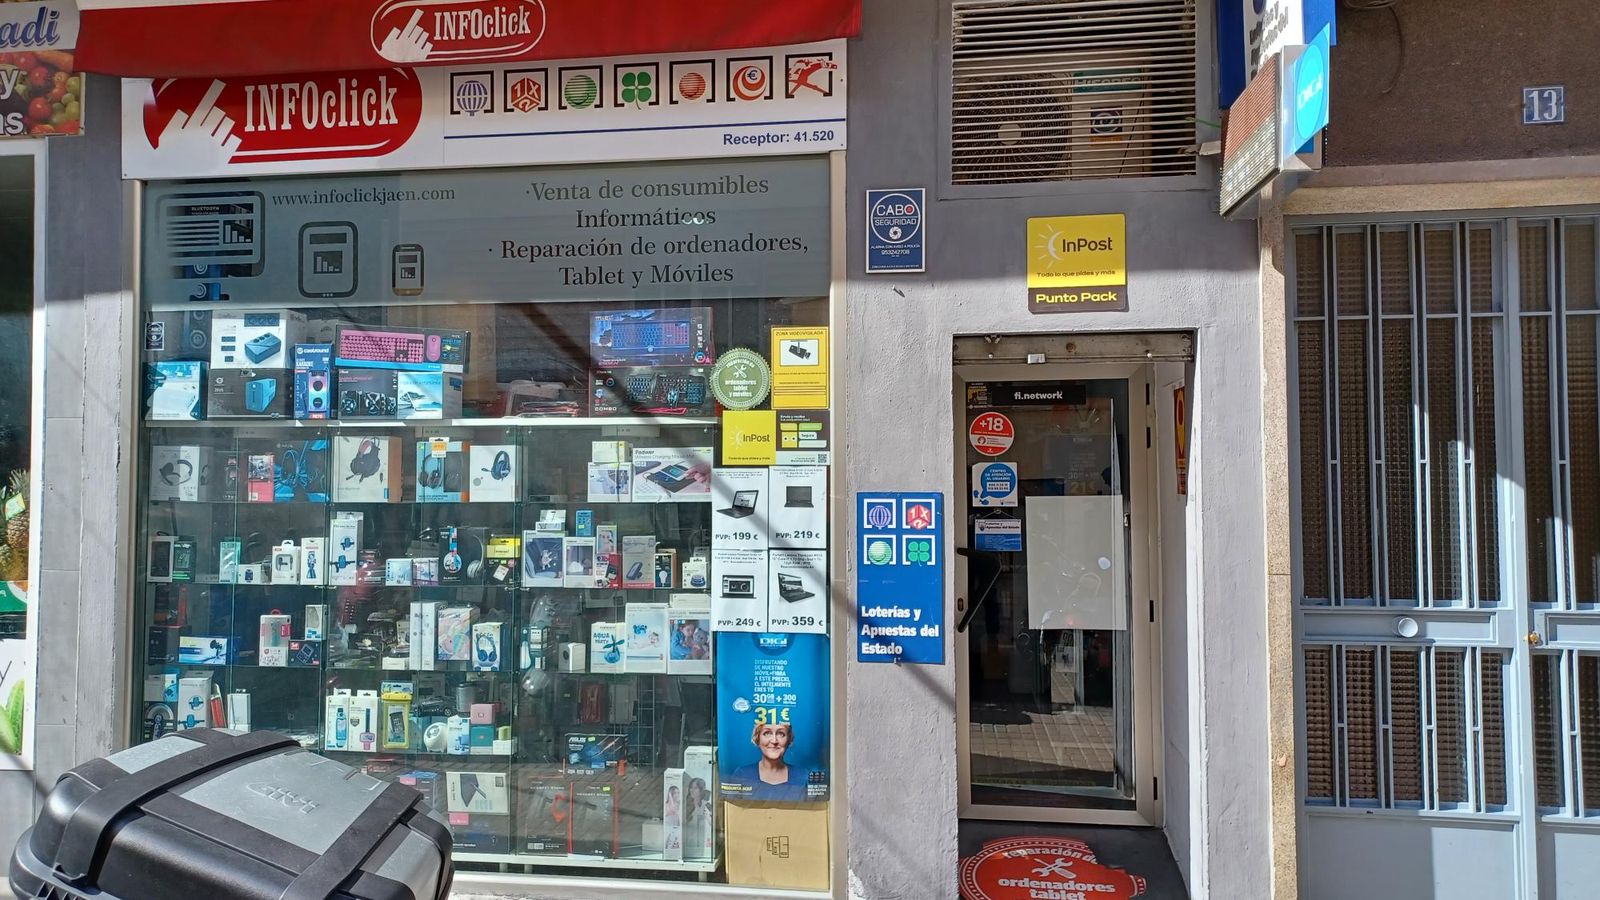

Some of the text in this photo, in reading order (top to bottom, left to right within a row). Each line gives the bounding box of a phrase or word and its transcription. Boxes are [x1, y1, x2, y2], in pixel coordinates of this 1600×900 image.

[433, 7, 532, 40] INFOclick
[244, 75, 399, 133] INFOclick
[1528, 89, 1557, 121] 13
[0, 112, 24, 135] s
[723, 129, 834, 146] Receptor: 41.520
[598, 179, 625, 199] de
[631, 174, 769, 198] consumibles
[271, 186, 456, 207] www.infoclickjaen.com
[575, 205, 717, 229] Informáticos
[876, 204, 915, 216] CABO
[874, 218, 917, 226] SEGURIDAD
[500, 232, 809, 262] Reparación de ordenadores,
[1062, 236, 1113, 253] InPost
[559, 262, 735, 289] Tablet y Móviles
[1075, 271, 1094, 279] pides
[1036, 291, 1118, 304] Punto Pack
[979, 416, 1004, 431] +18
[743, 434, 770, 443] InPost
[732, 532, 751, 540] 199
[793, 531, 813, 539] 219
[771, 618, 790, 626] PVP:
[792, 616, 814, 626] 359
[861, 606, 921, 621] Loterías y
[735, 618, 754, 626] 249
[861, 624, 940, 638] Apuestas del
[861, 643, 903, 655] Estado
[753, 693, 767, 704] 30
[754, 707, 790, 727] 31 €
[1002, 847, 1082, 860] reparación
[998, 877, 1116, 893] ordenadores
[1030, 889, 1087, 900] tablet
